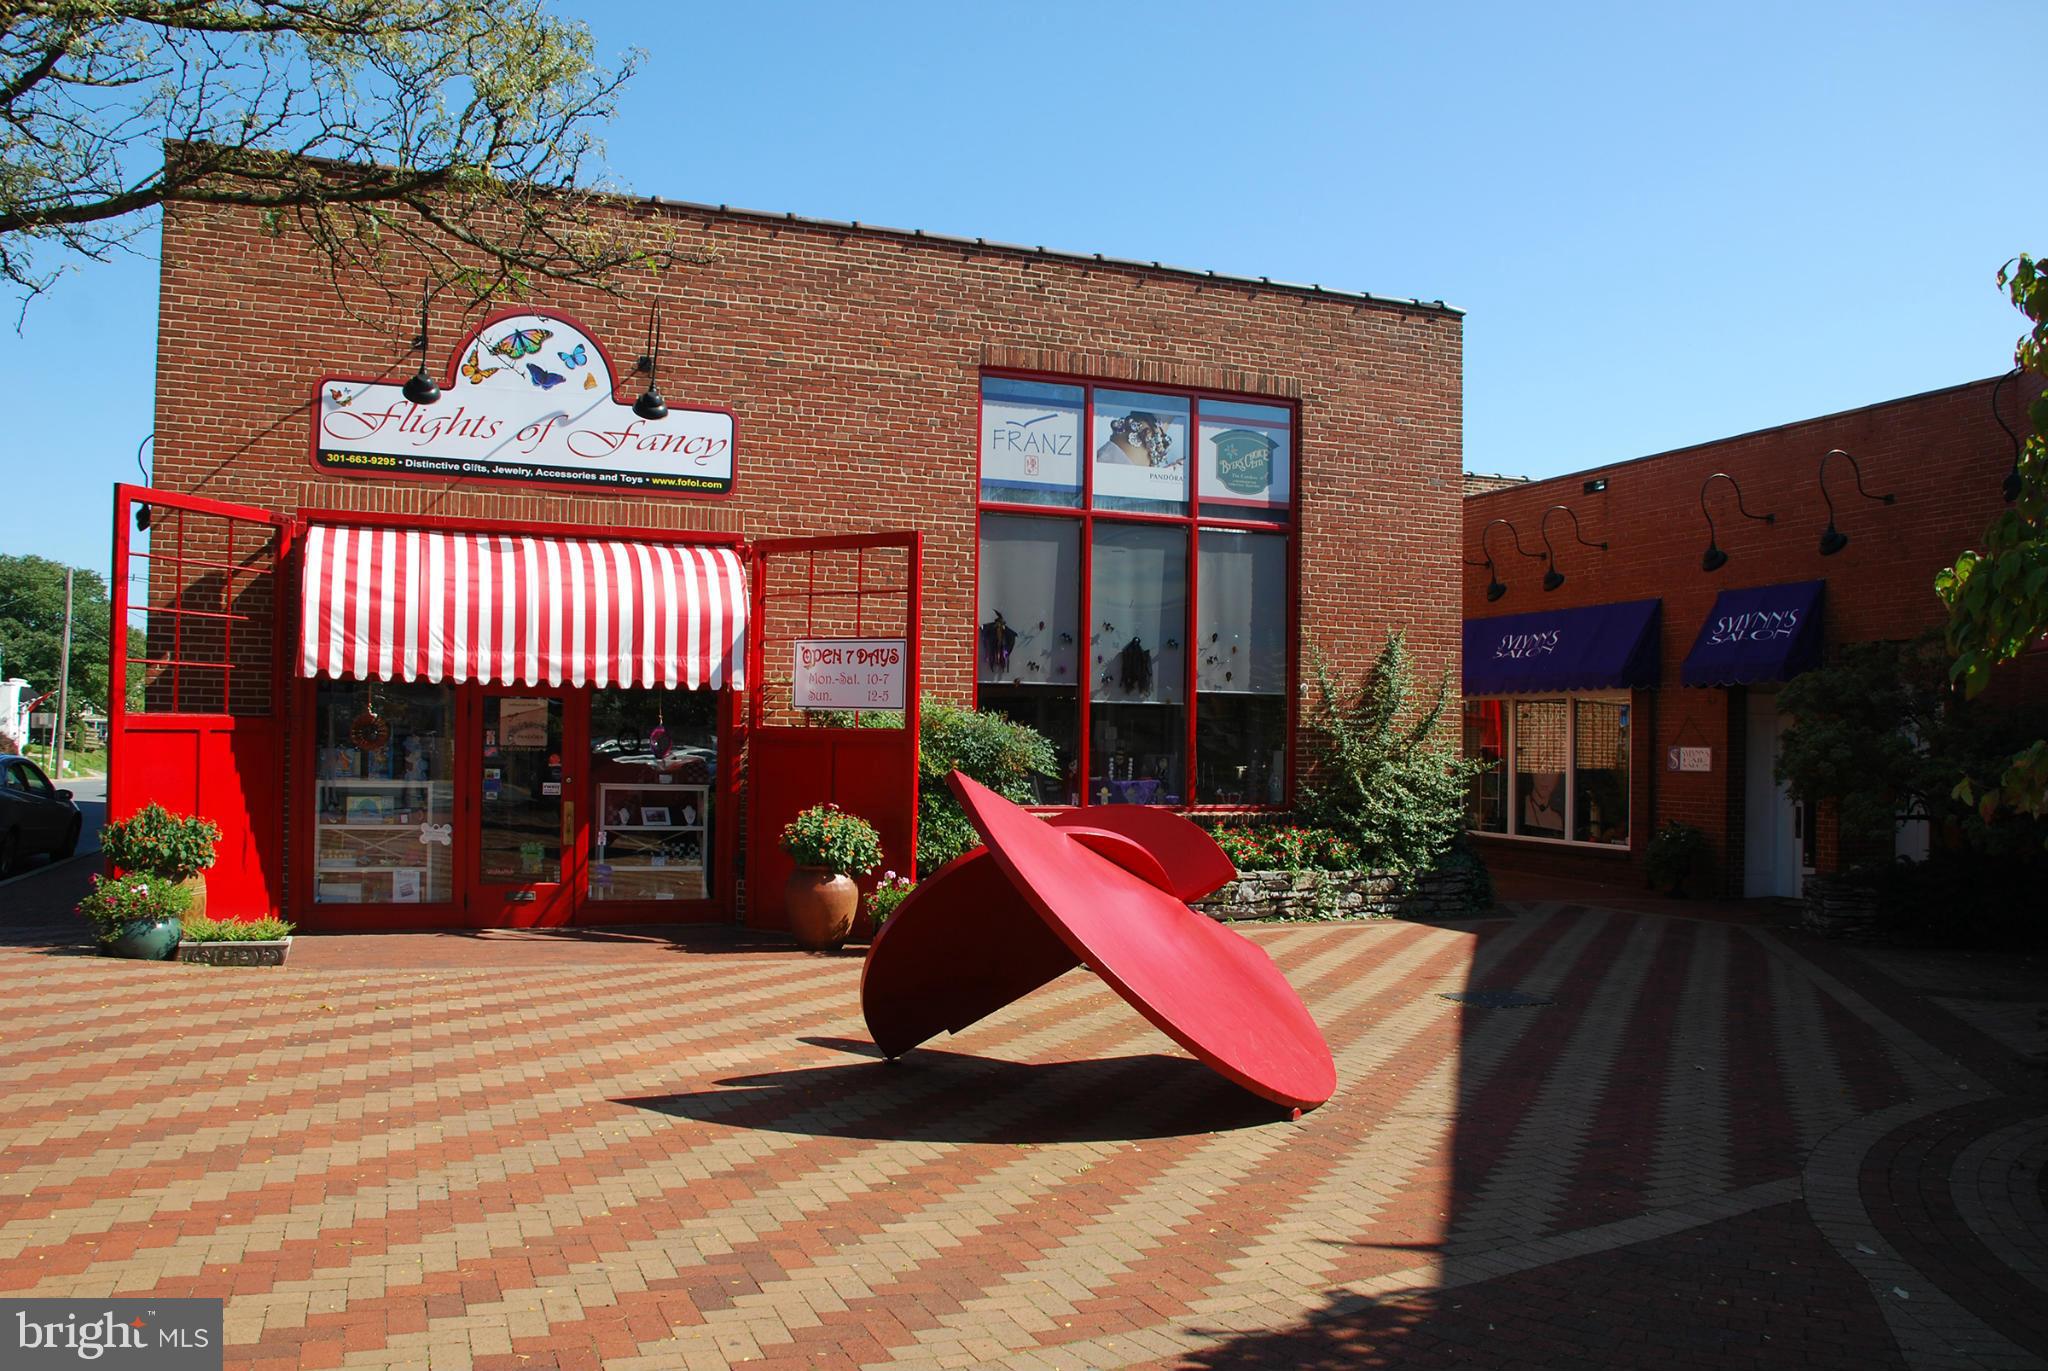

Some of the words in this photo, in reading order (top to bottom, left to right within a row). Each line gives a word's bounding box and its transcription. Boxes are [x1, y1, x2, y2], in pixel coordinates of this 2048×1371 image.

[323, 401, 503, 446] Flights
[516, 415, 568, 454] of
[567, 420, 727, 466] Fancy
[993, 429, 1072, 456] FRANZ
[326, 453, 396, 466] 301-663-9295
[405, 459, 460, 471] Distinctive
[462, 463, 490, 474] Gifts,
[492, 465, 534, 477] Jewelry,
[535, 468, 596, 481] Accessories
[599, 472, 618, 482] and
[619, 474, 643, 484] Toys
[1706, 629, 1793, 645] SALON
[802, 648, 842, 666] OPEN
[846, 650, 854, 665] 7
[856, 648, 899, 667] DAYS
[867, 673, 890, 685] 10-7
[808, 690, 832, 702] Sun.
[867, 690, 889, 702] 12-5
